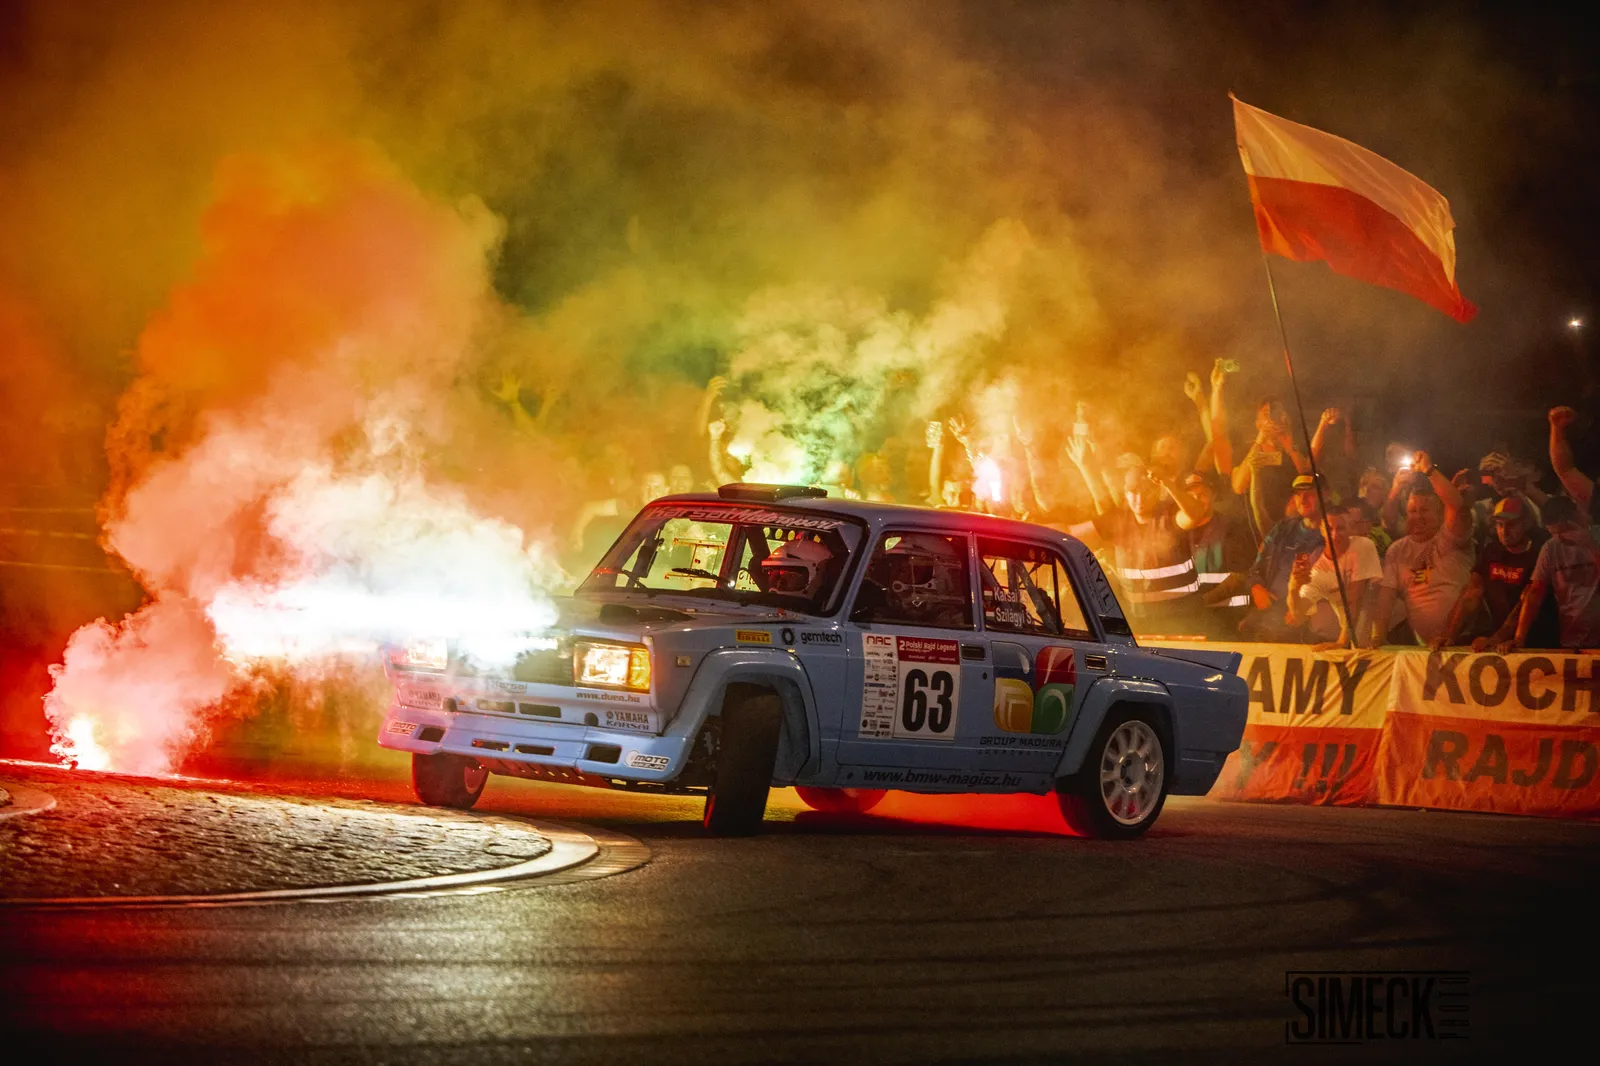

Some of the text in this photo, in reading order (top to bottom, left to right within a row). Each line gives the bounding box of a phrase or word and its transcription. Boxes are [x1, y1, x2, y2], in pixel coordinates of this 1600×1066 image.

[731, 510, 840, 529] Motorsport
[994, 586, 1018, 602] Karsai
[996, 607, 1025, 627] Szilágyi
[801, 631, 842, 644] gemtech
[899, 640, 906, 651] 2
[906, 641, 923, 650] Polski
[924, 642, 936, 652] Rajd
[937, 643, 956, 653] Legend
[576, 691, 641, 703] www.duen.hu
[902, 668, 954, 733] 63
[614, 710, 649, 724] YAMAHA
[393, 721, 417, 730] MOTO
[980, 736, 1062, 748] GROUP MADURA
[635, 755, 670, 765] MOTO
[1422, 729, 1599, 790] RAJD
[864, 769, 1022, 787] www.bmw-magisz.hu
